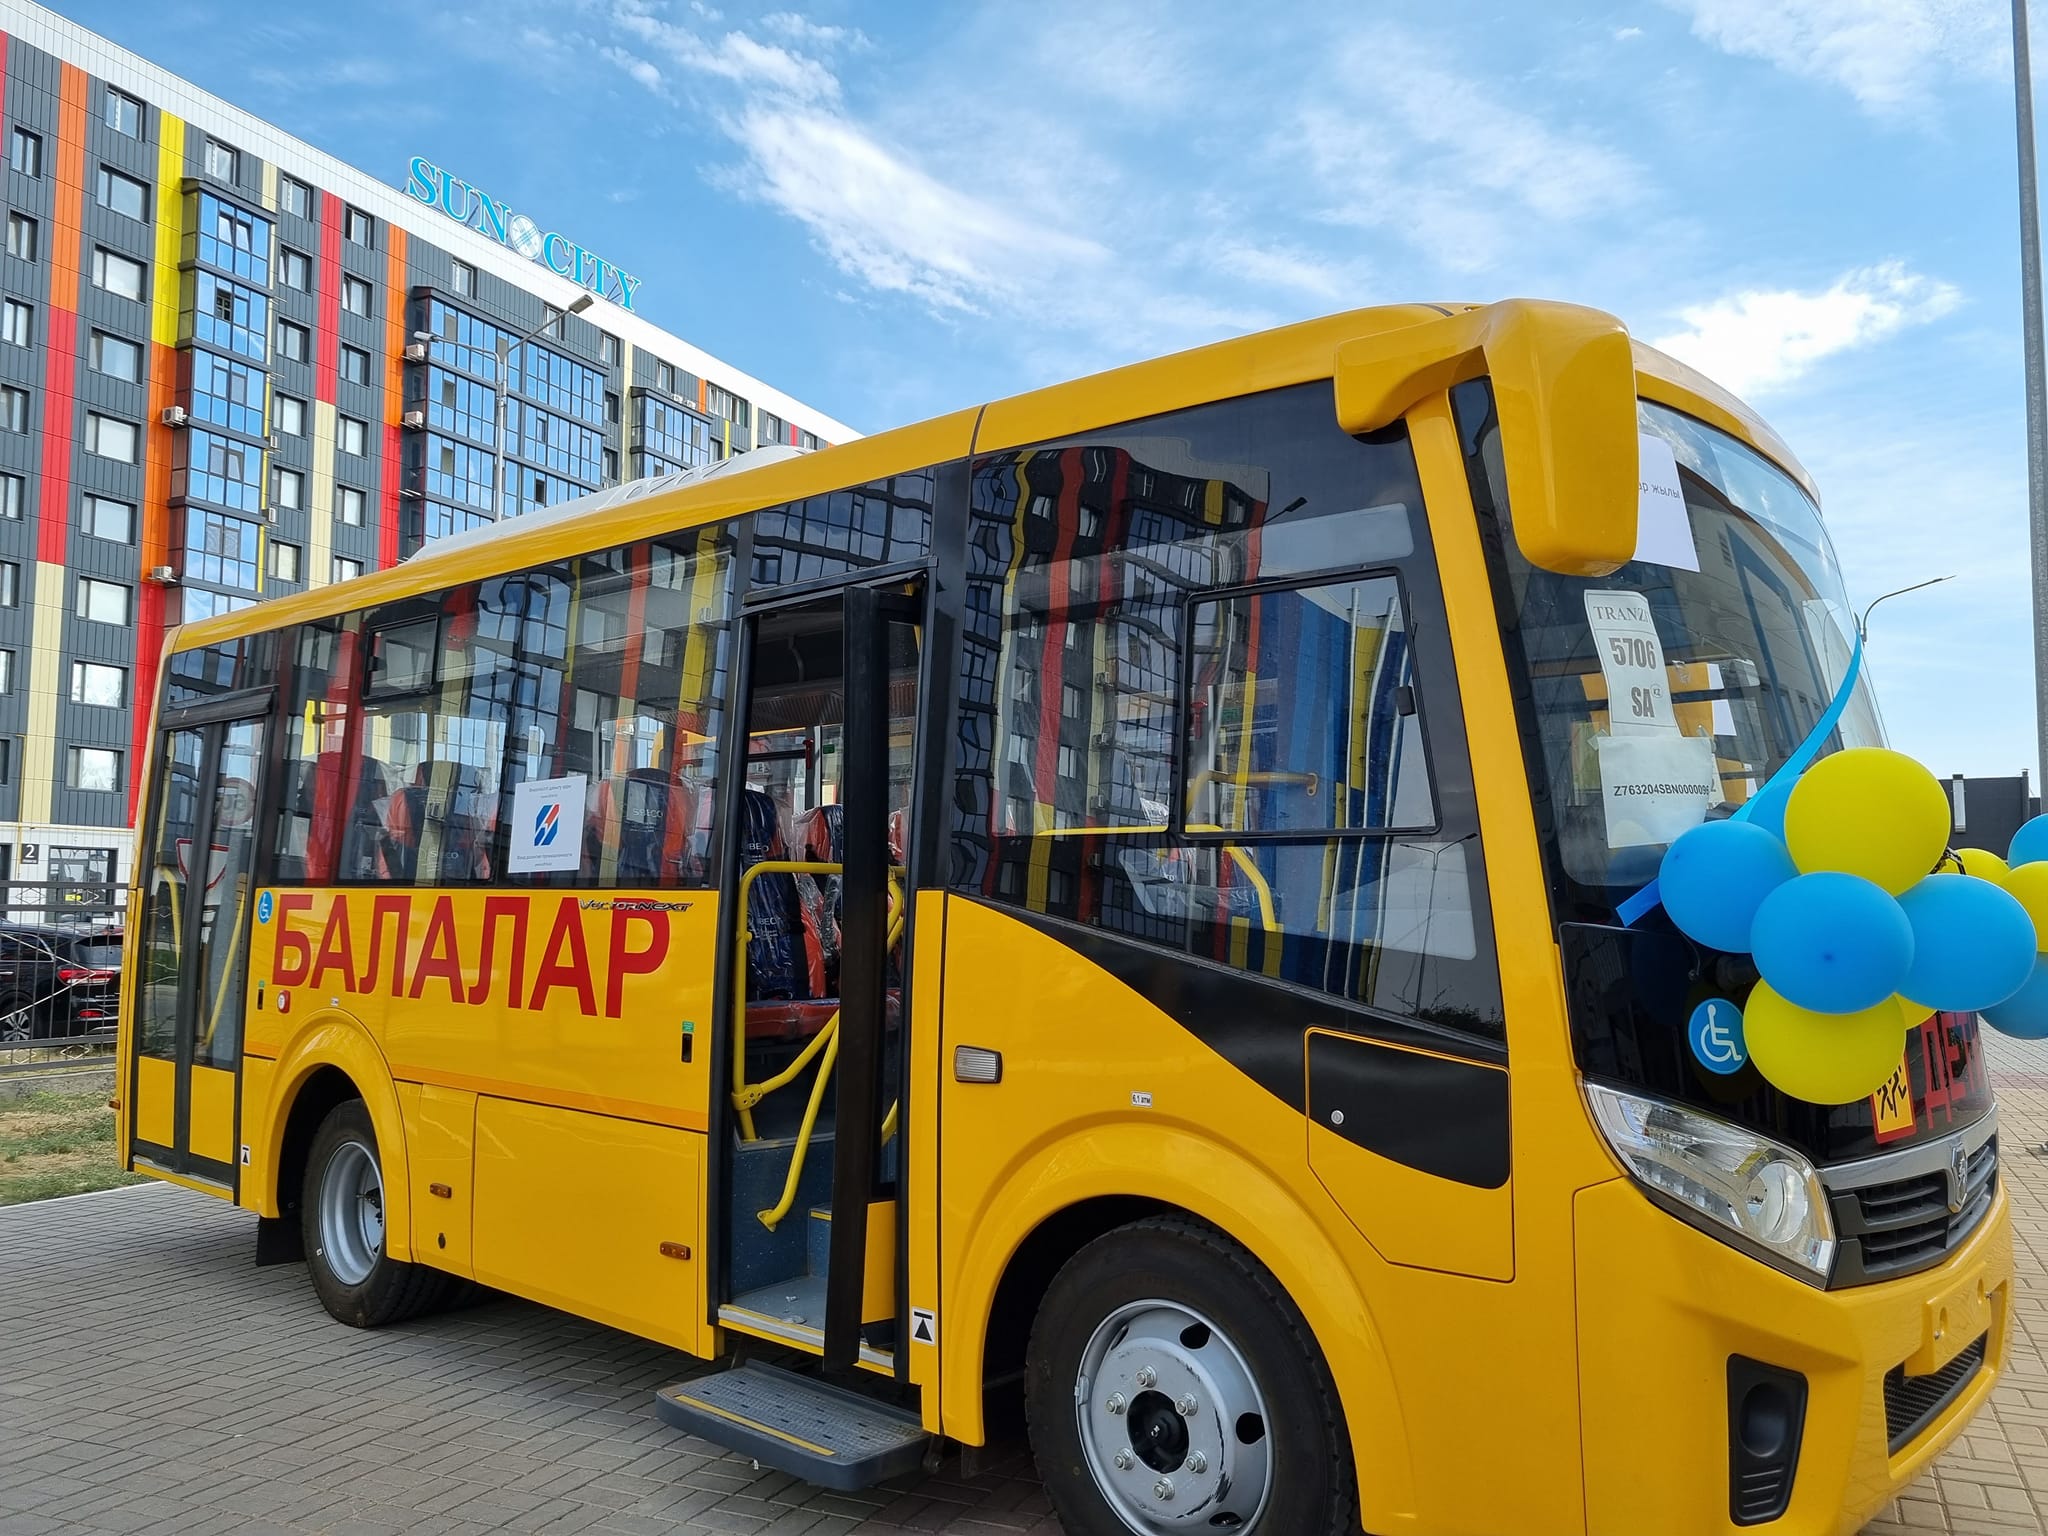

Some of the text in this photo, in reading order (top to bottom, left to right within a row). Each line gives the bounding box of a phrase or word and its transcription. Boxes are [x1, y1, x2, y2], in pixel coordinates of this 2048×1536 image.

[408, 156, 642, 313] SUN CITY
[1608, 637, 1657, 670] 5706
[1631, 686, 1655, 718] SA
[25, 844, 35, 858] 2
[272, 894, 671, 1019] БАЛАЛАР
